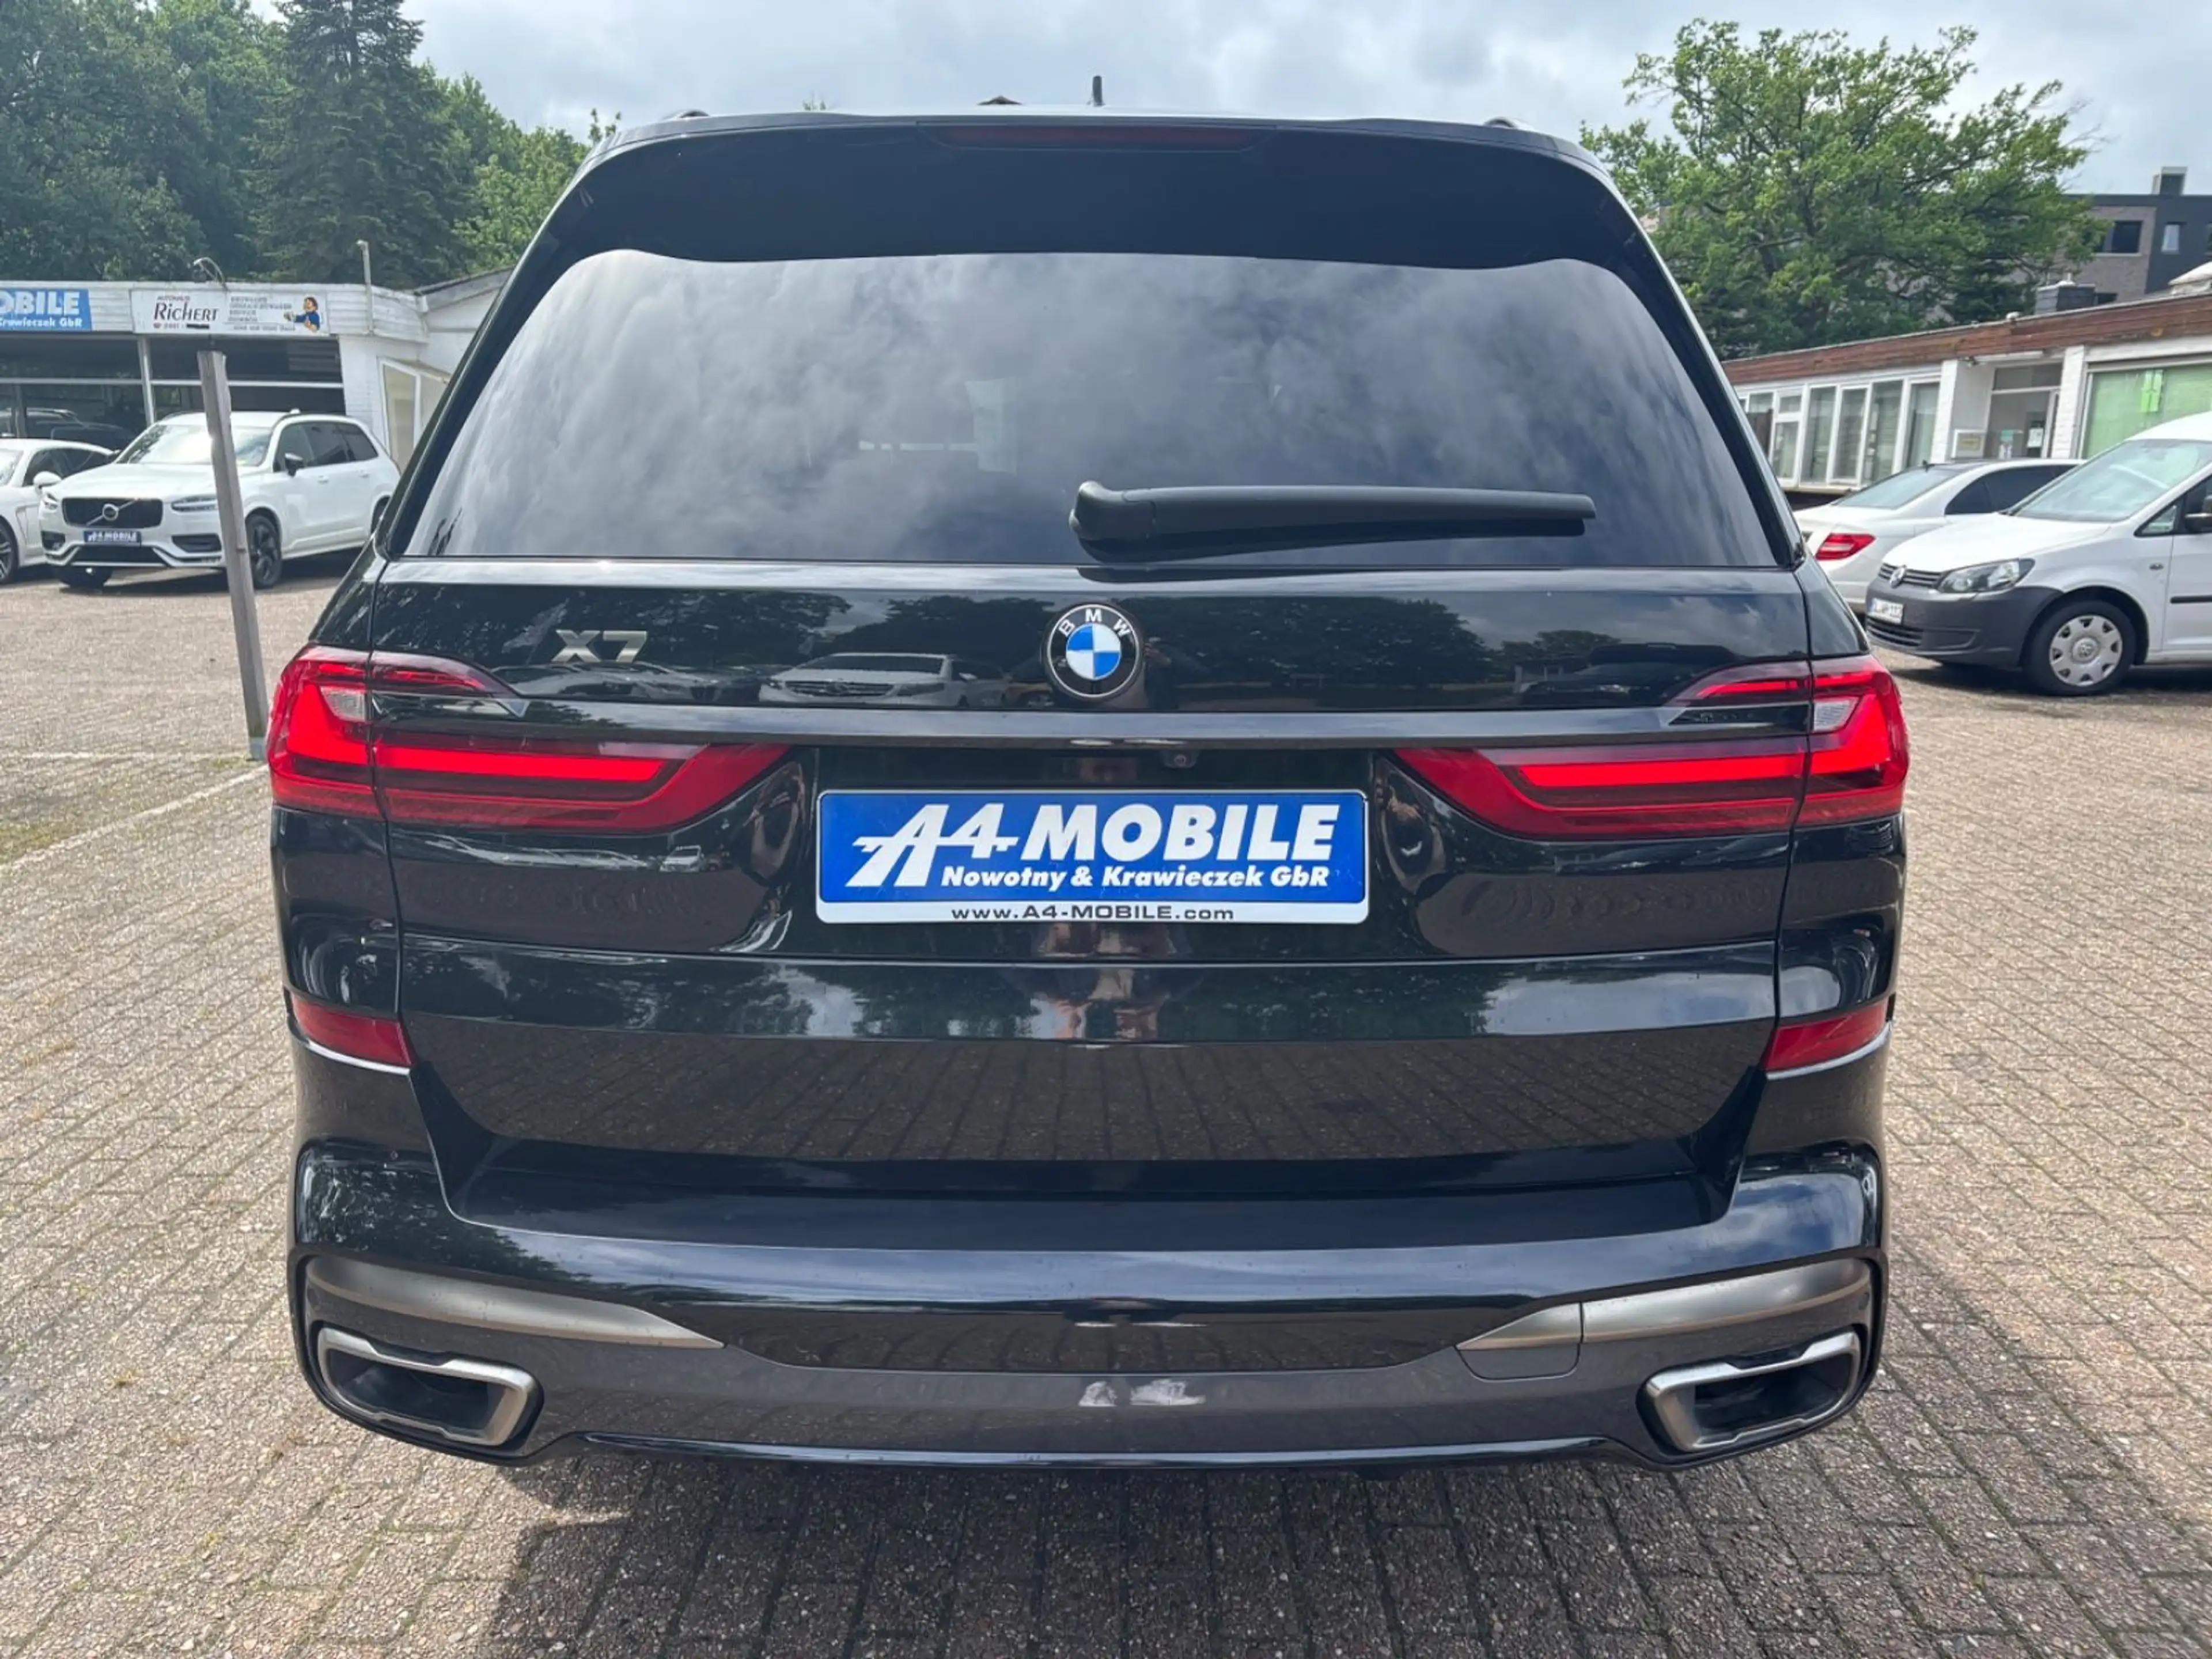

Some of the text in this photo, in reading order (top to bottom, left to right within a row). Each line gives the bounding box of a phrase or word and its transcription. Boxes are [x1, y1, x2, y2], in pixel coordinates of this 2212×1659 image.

[1059, 608, 1130, 637] BMW
[551, 630, 647, 662] X7
[941, 865, 1330, 892] Nowotny & Krawieczek GbR
[951, 905, 1234, 920] www.A4-MOBILE.com
